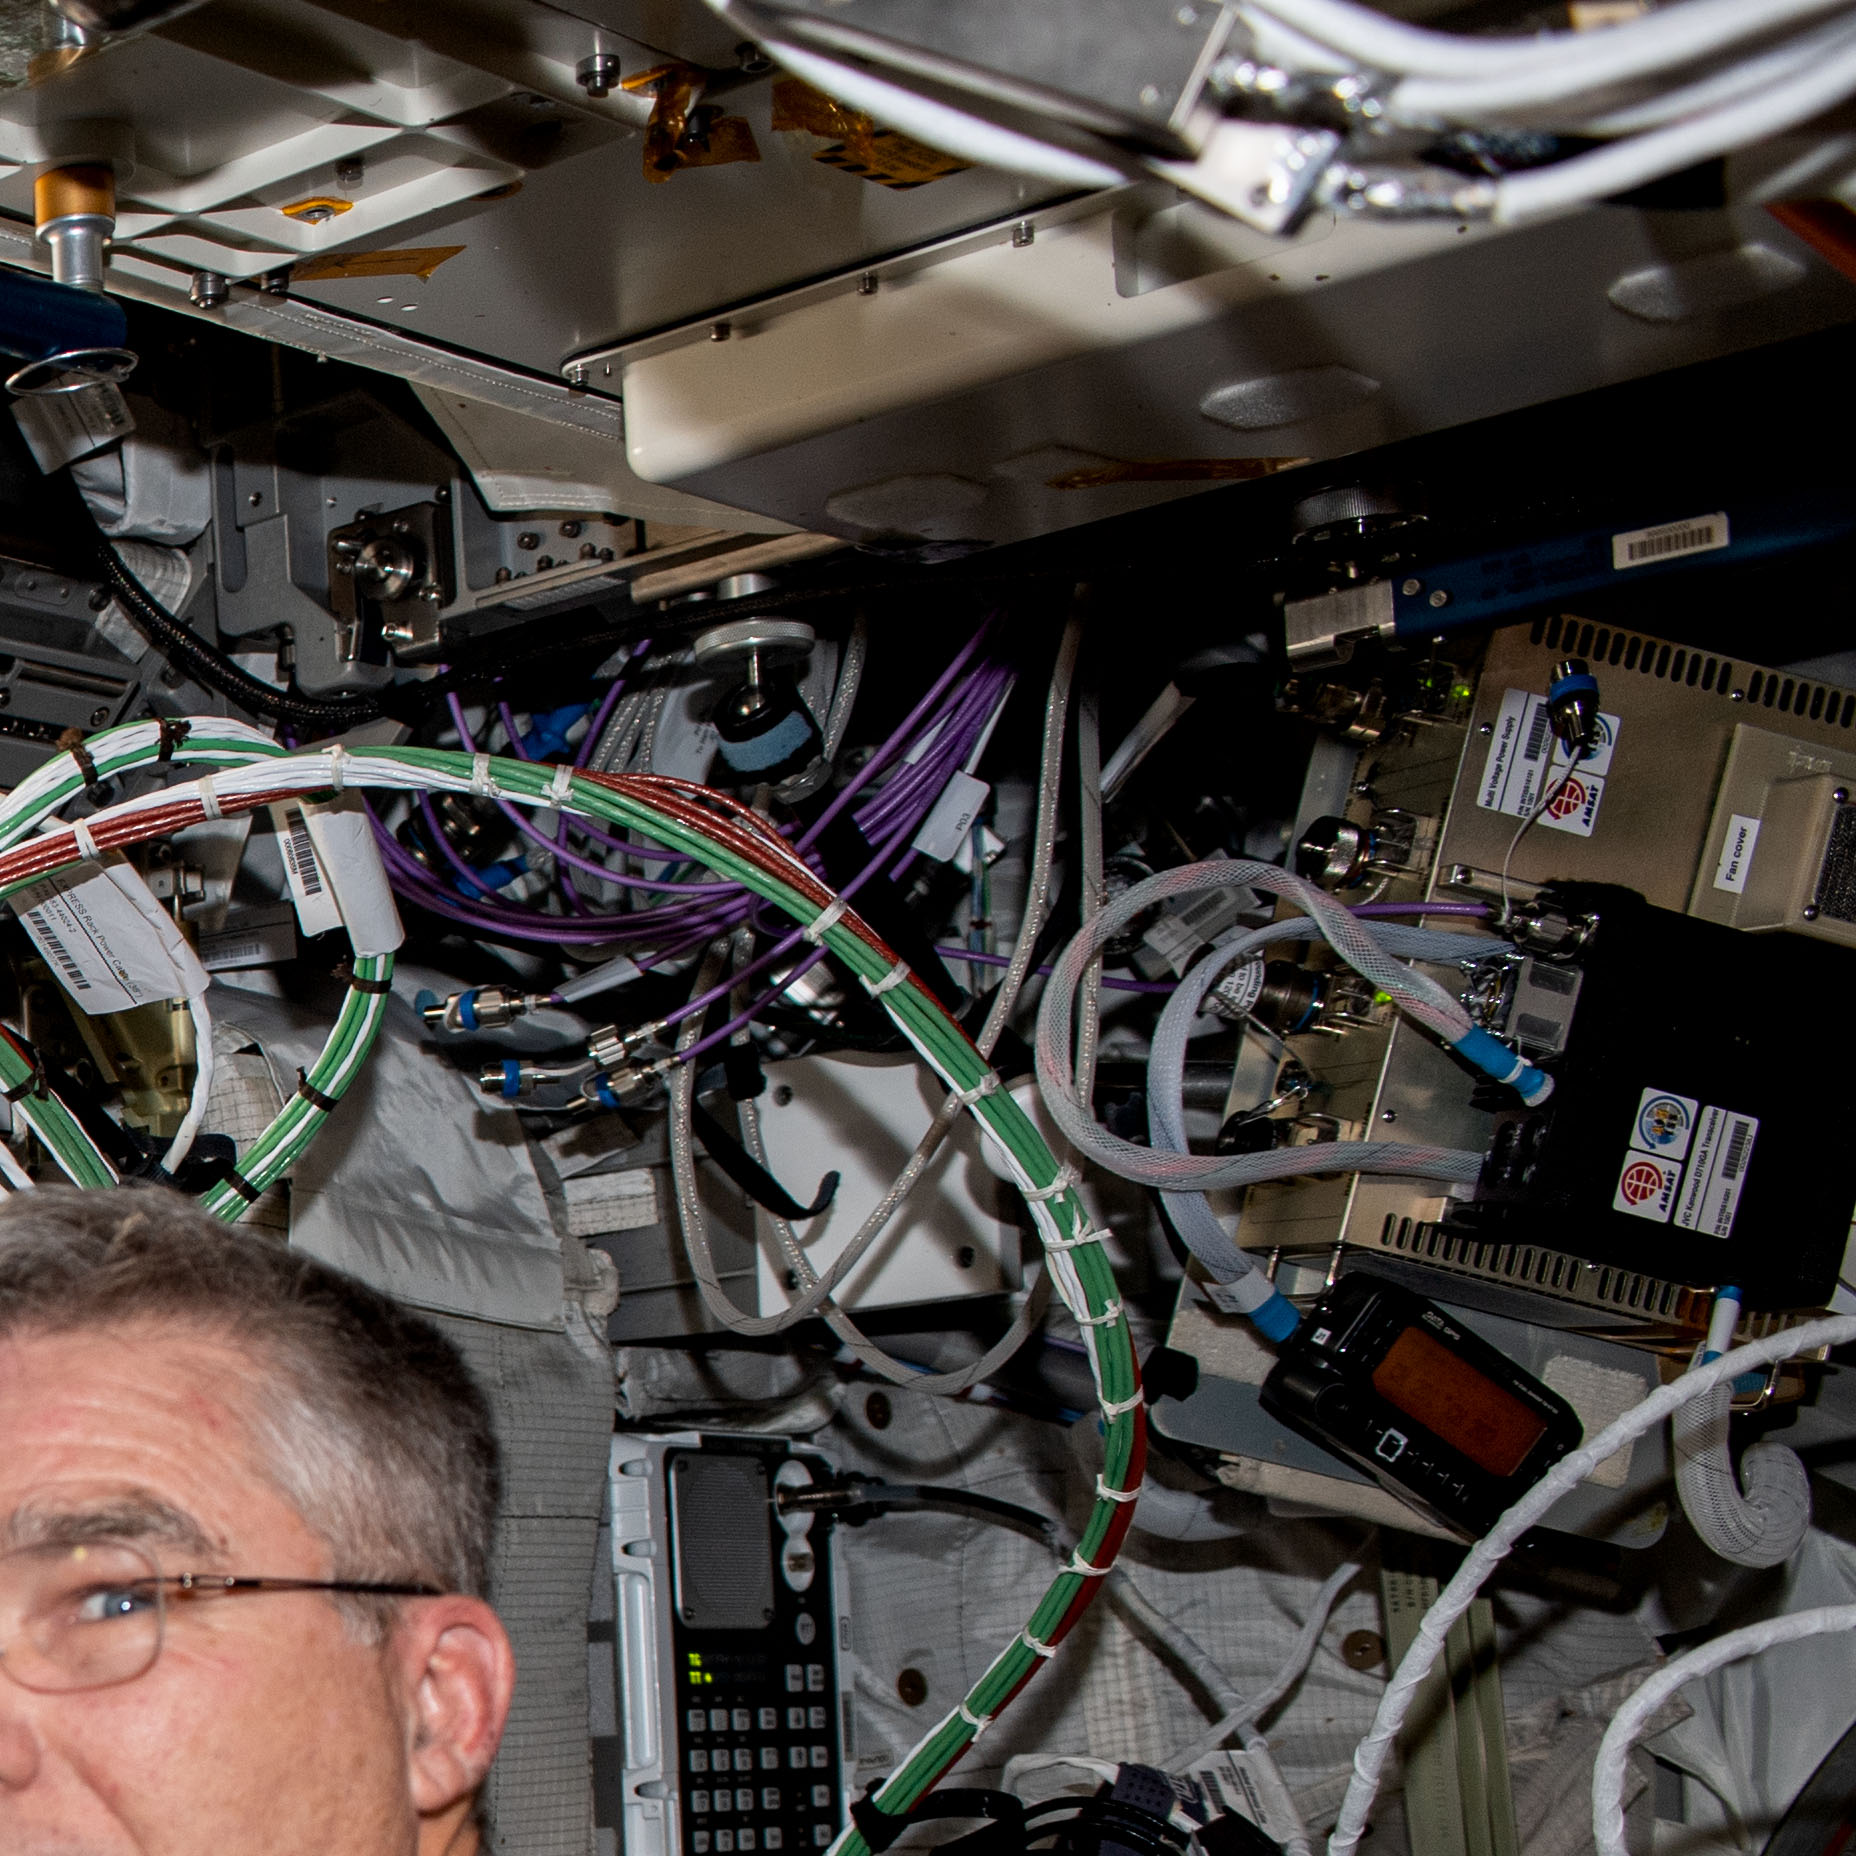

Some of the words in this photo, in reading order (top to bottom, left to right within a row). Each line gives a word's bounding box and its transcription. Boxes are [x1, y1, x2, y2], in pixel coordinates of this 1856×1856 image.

[1488, 762, 1500, 790] Voltage
[1495, 742, 1508, 765] Power
[1502, 715, 1516, 742] Supply
[1581, 784, 1600, 827] AMSAT
[1725, 860, 1741, 882] Fan
[1733, 826, 1748, 858] cover
[1700, 1108, 1720, 1151] Transceiver
[1659, 1169, 1678, 1212] AMSAT
[1685, 1178, 1702, 1213] Kenwood
[1682, 1212, 1694, 1229] JVC
